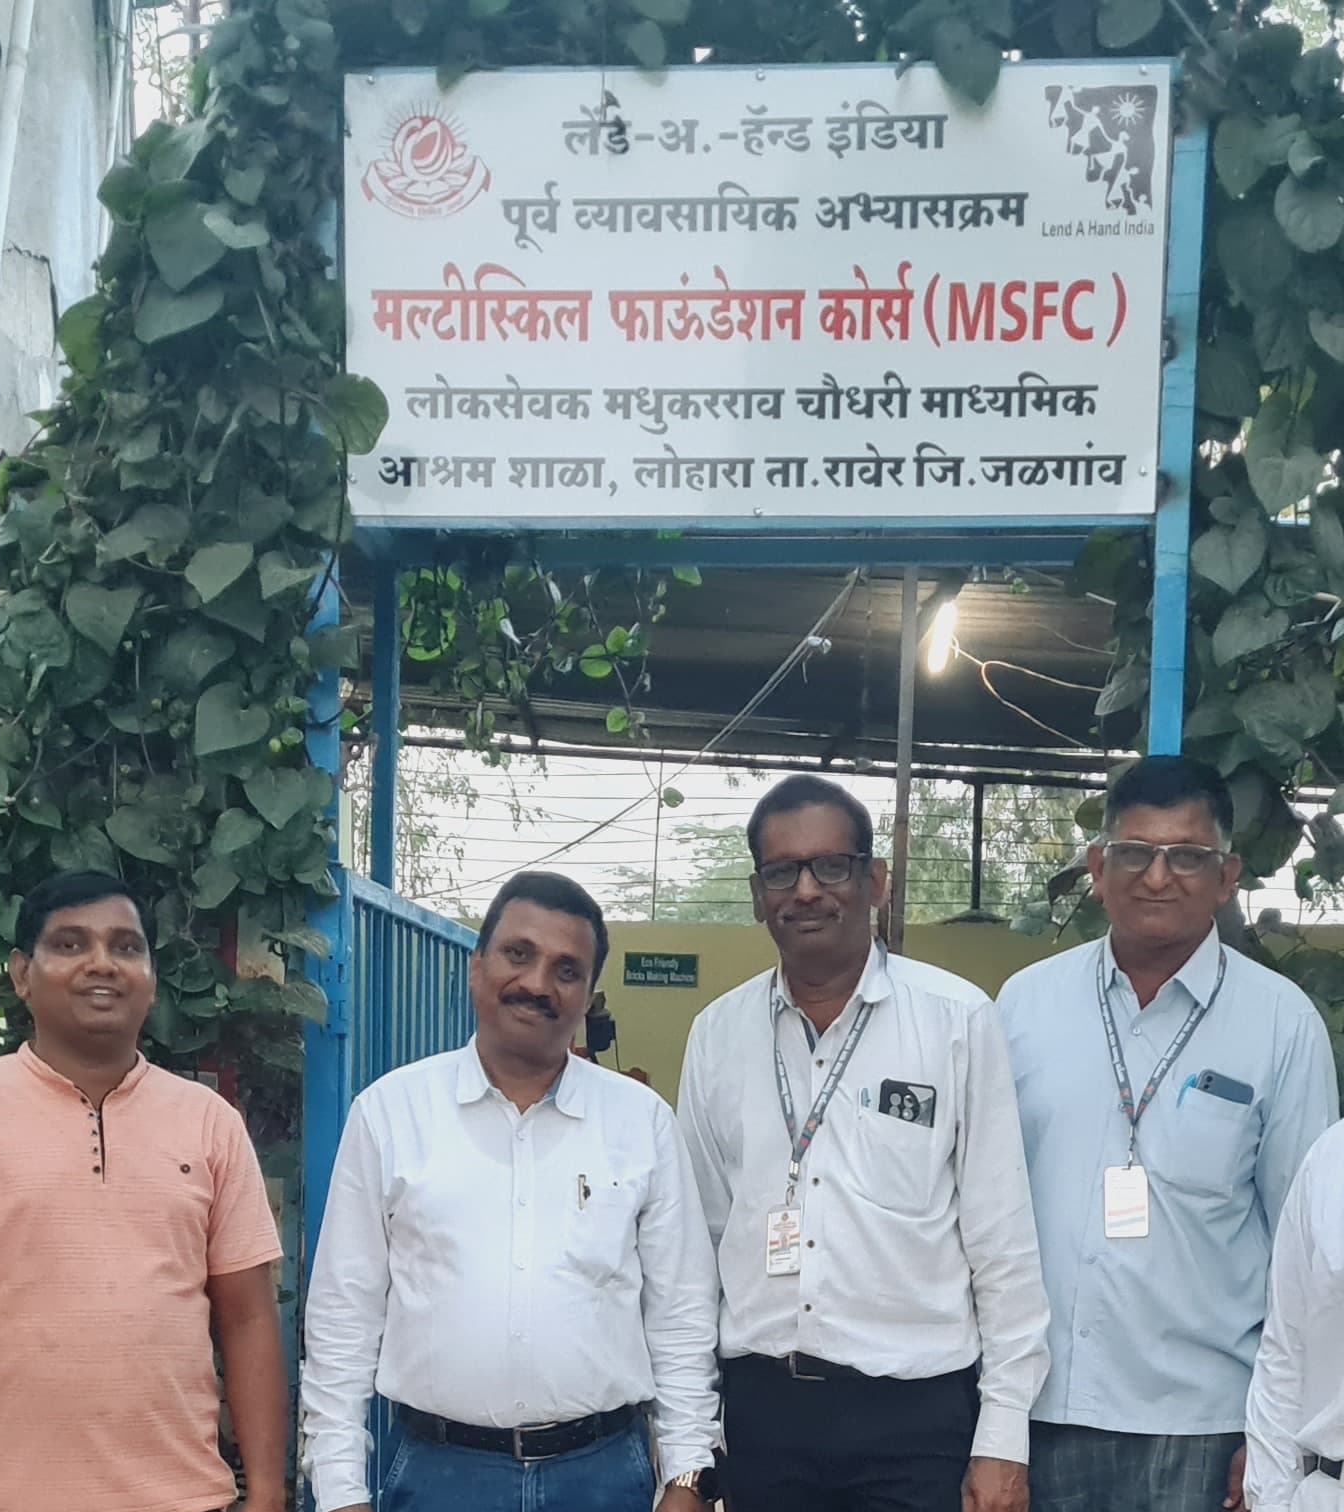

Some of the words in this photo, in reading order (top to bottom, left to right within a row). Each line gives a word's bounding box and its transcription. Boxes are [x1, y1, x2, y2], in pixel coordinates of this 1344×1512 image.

[825, 100, 949, 160] इंडिया
[501, 181, 561, 253] पूर्व
[572, 181, 800, 233] व्यावसायिक
[815, 191, 1029, 232] अभ्यासक्रम
[1041, 221, 1073, 238] Lend
[1076, 221, 1085, 236] A
[1088, 221, 1121, 237] Hand
[1124, 220, 1155, 236] India
[371, 261, 593, 341] मल्टीस्किल
[608, 264, 806, 341] फाऊंडेशन
[818, 260, 914, 341] कोर्स
[404, 372, 593, 420] लोकसेवक
[603, 385, 785, 435] मधुकरराव
[796, 371, 911, 420] चौधरी
[920, 370, 1099, 420] माध्यमिक
[378, 454, 496, 489] आश्रम
[508, 455, 619, 497] शाळा,
[633, 443, 755, 490] लोहारा
